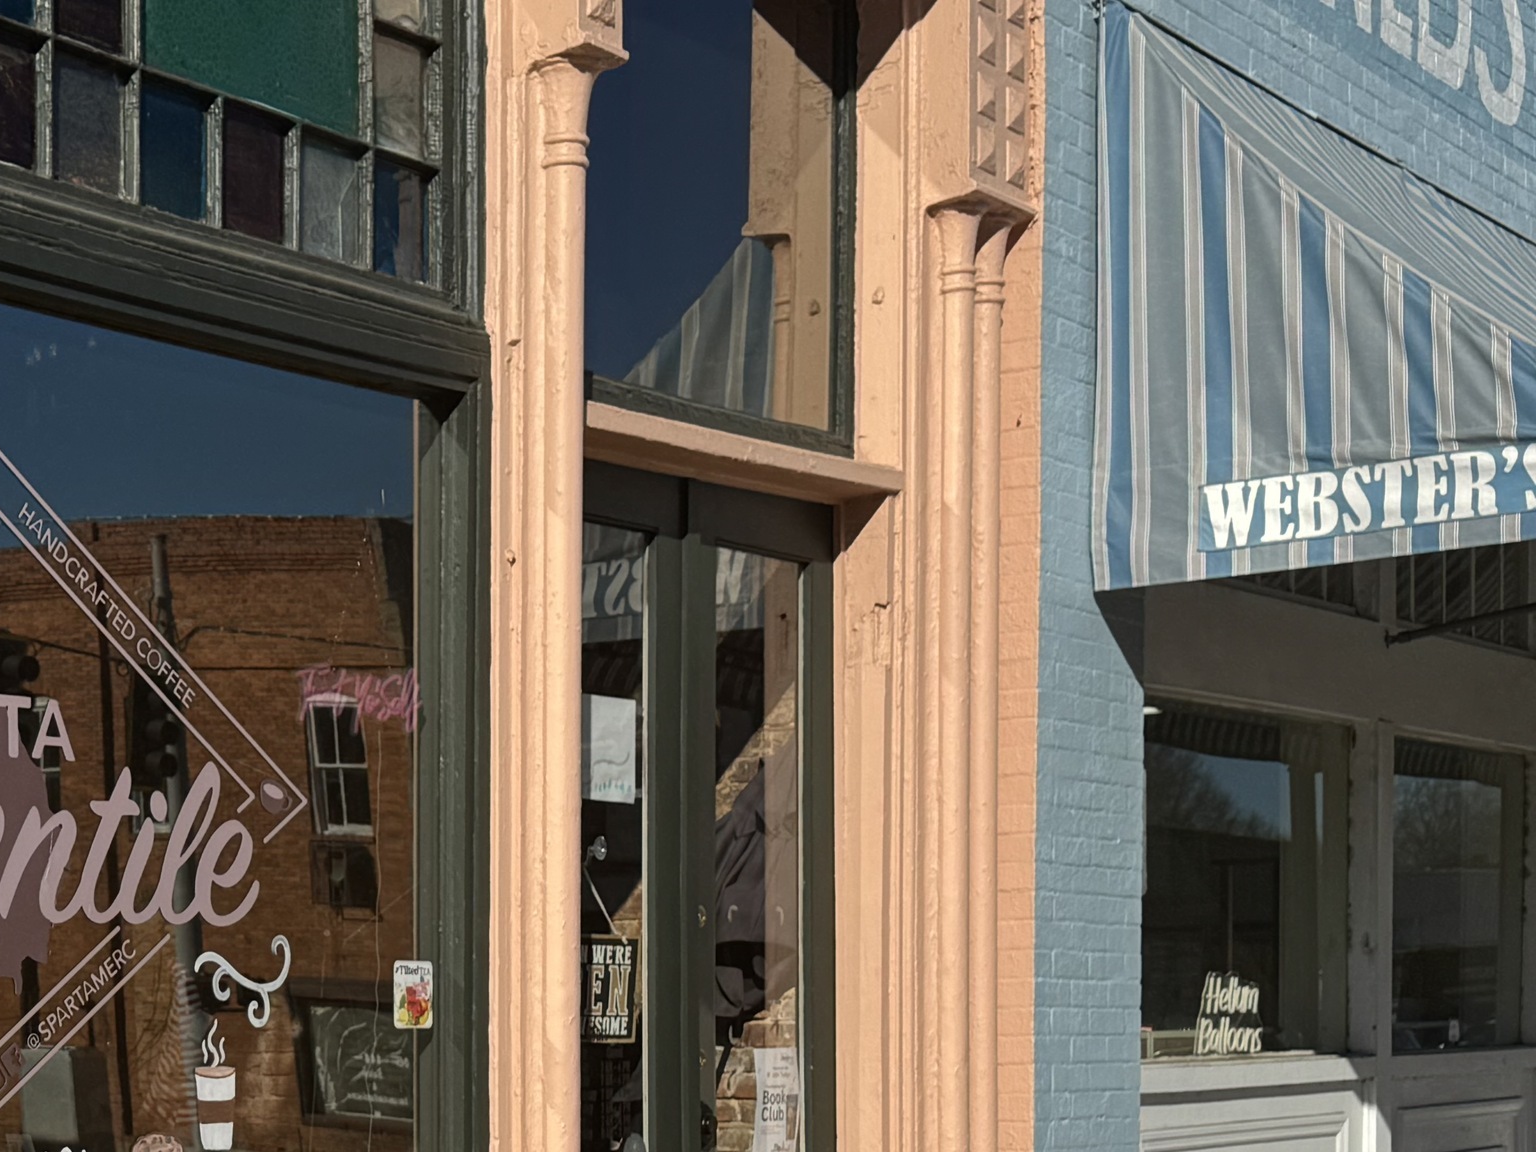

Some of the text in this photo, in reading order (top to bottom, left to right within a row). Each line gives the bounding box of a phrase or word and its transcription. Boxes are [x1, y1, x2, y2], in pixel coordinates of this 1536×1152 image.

[18, 501, 197, 710] HANDCRAFTED COFFEE
[25, 938, 138, 1051] @SPARTAMERC
[586, 964, 632, 1016] EN
[1205, 975, 1260, 1014] Helium
[1197, 1015, 1263, 1055] Balloons
[761, 1105, 785, 1122] Club
[762, 1089, 787, 1105] Book
